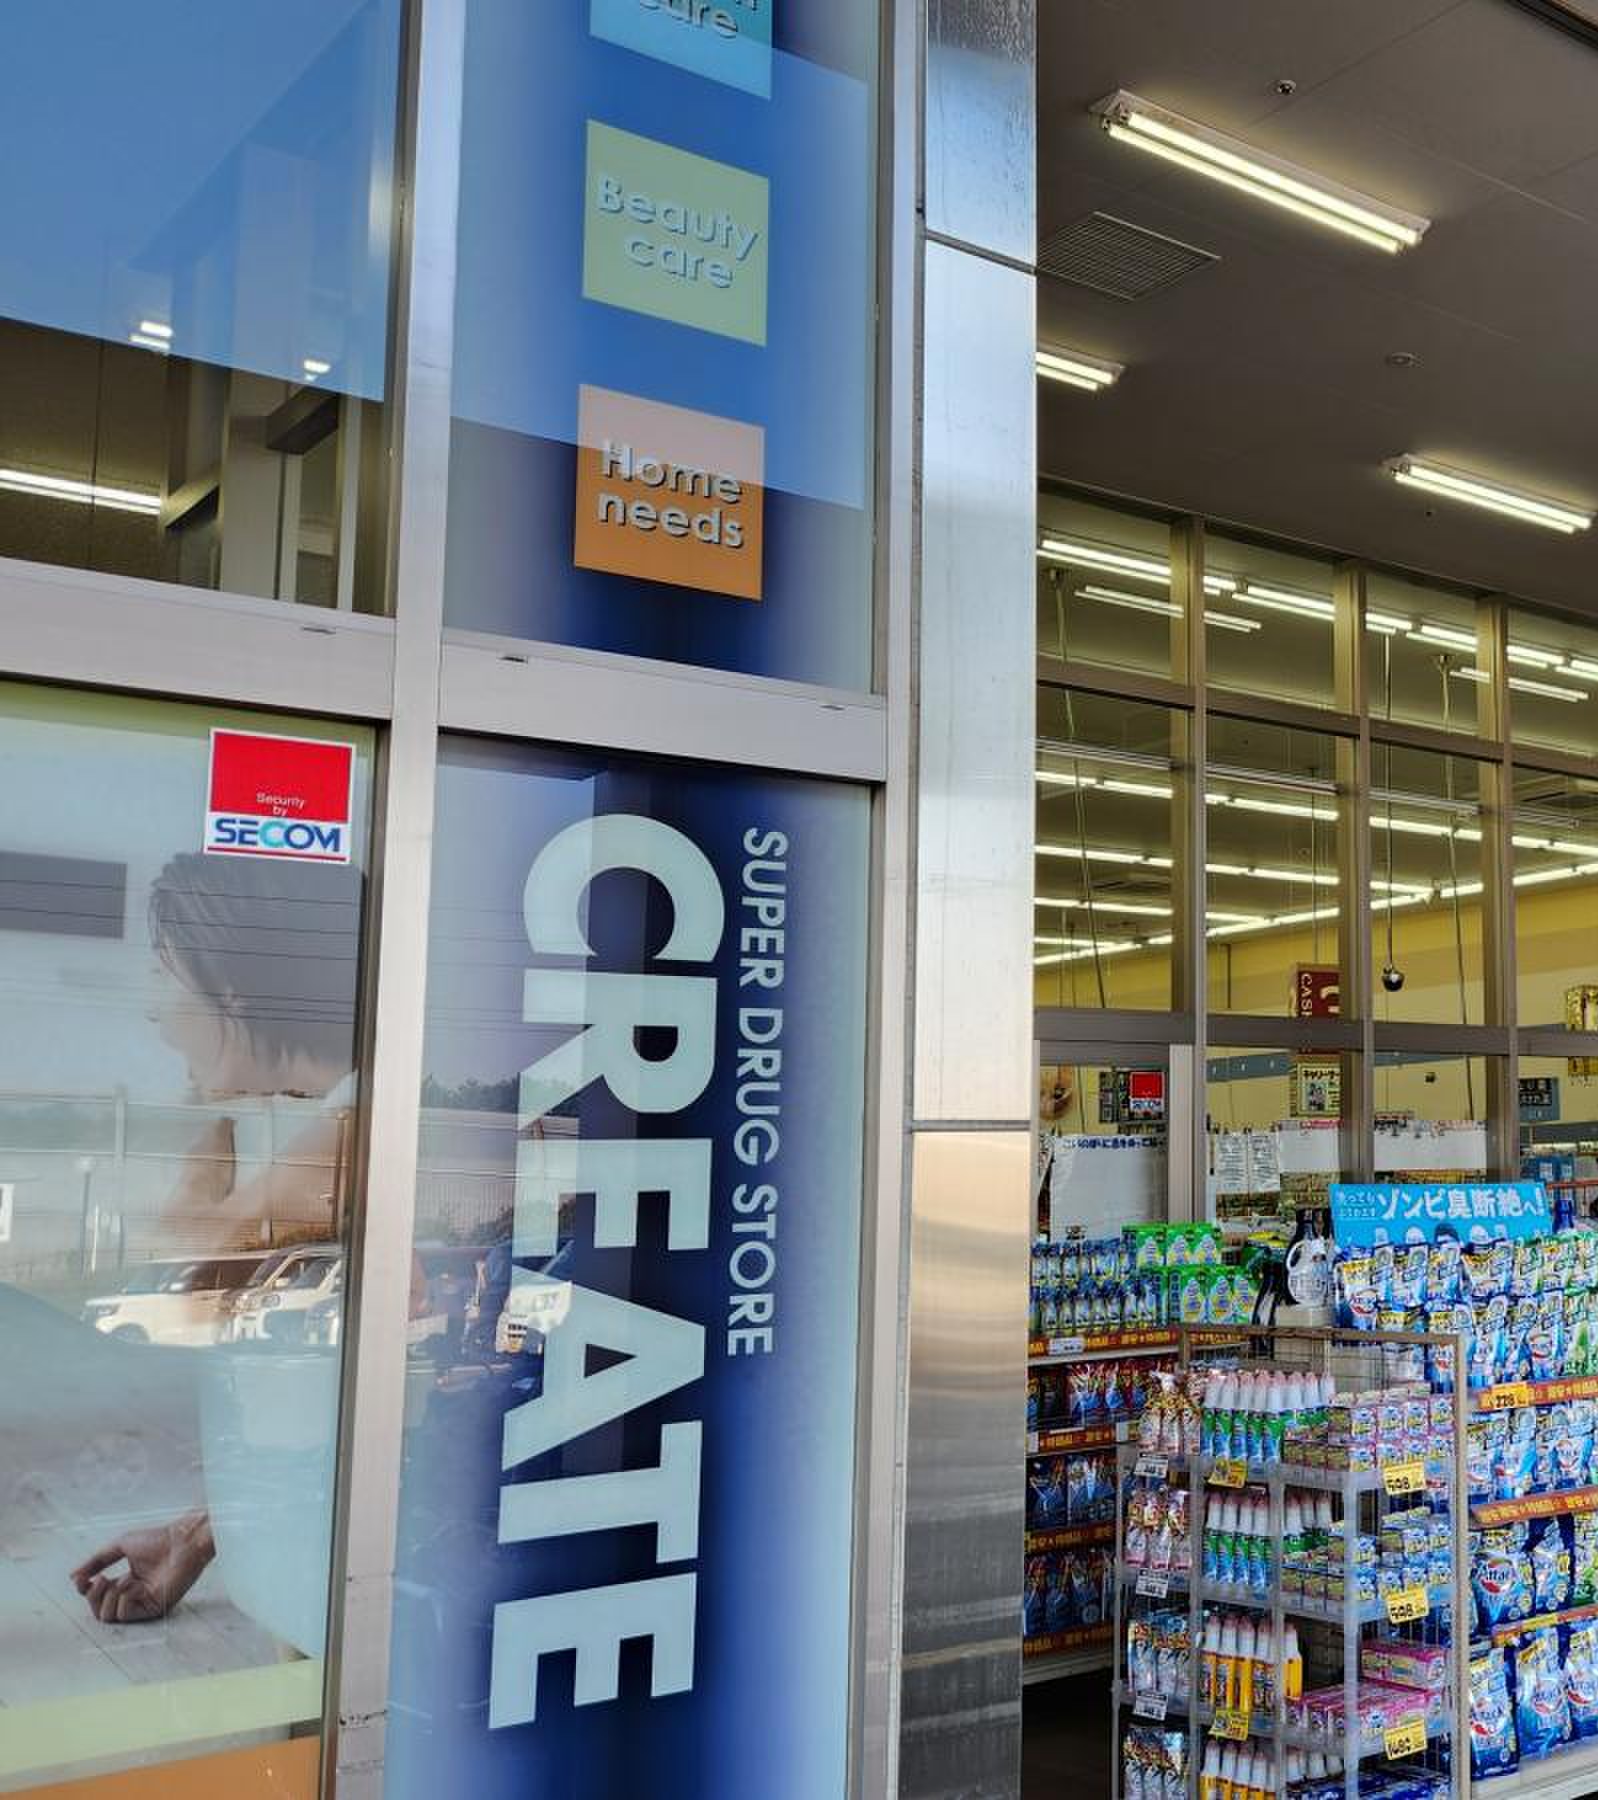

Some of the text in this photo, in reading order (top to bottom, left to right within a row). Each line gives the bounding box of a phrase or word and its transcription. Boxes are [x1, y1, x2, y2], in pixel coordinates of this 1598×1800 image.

[599, 175, 758, 261] Beauty
[628, 239, 734, 288] care
[603, 440, 742, 505] Home
[599, 493, 743, 549] needs
[256, 791, 305, 809] Security
[272, 806, 288, 817] by
[215, 817, 341, 852] SECOM
[727, 828, 787, 1357] SUPER DRUG STORE
[489, 814, 725, 1729] CREATE
